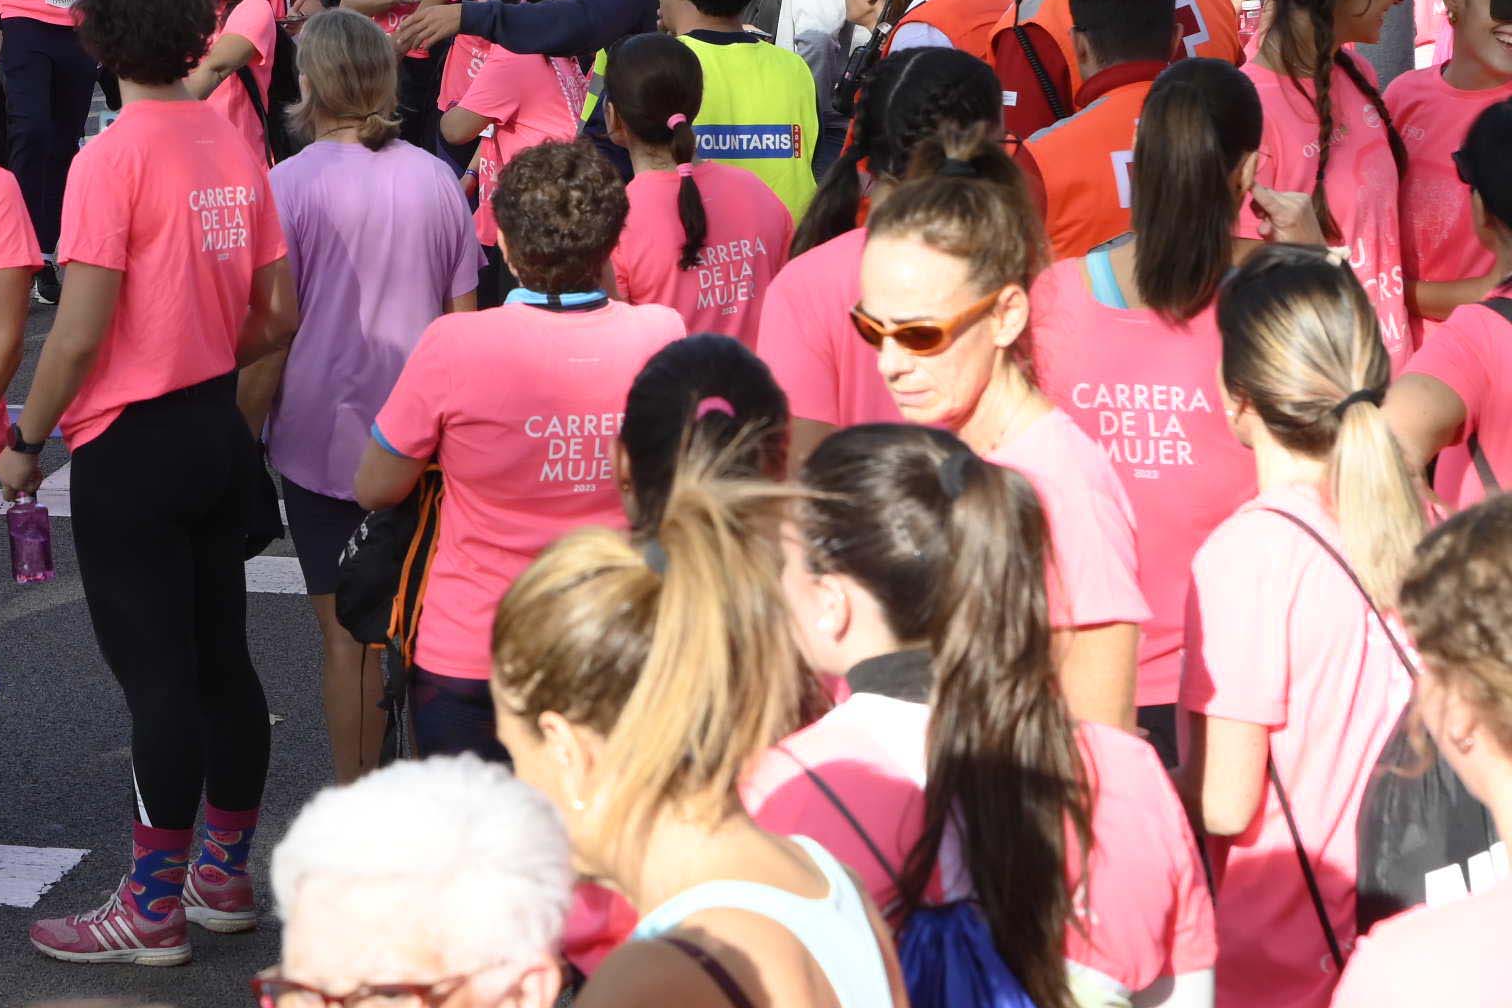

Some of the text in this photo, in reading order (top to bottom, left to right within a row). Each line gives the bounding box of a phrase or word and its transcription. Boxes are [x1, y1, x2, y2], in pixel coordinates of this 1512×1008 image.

[695, 133, 791, 151] VOLUNTARIS
[189, 187, 257, 212] CARRERA
[201, 209, 244, 231] DE LA
[200, 228, 247, 253] MUJER
[691, 236, 768, 269] ARRERA
[699, 263, 754, 290] DE LA
[1072, 382, 1211, 413] CARRERA
[1099, 412, 1185, 438] DE LA
[548, 438, 612, 460] DE L
[1102, 439, 1194, 466] MUJER
[573, 484, 596, 492] 2023
